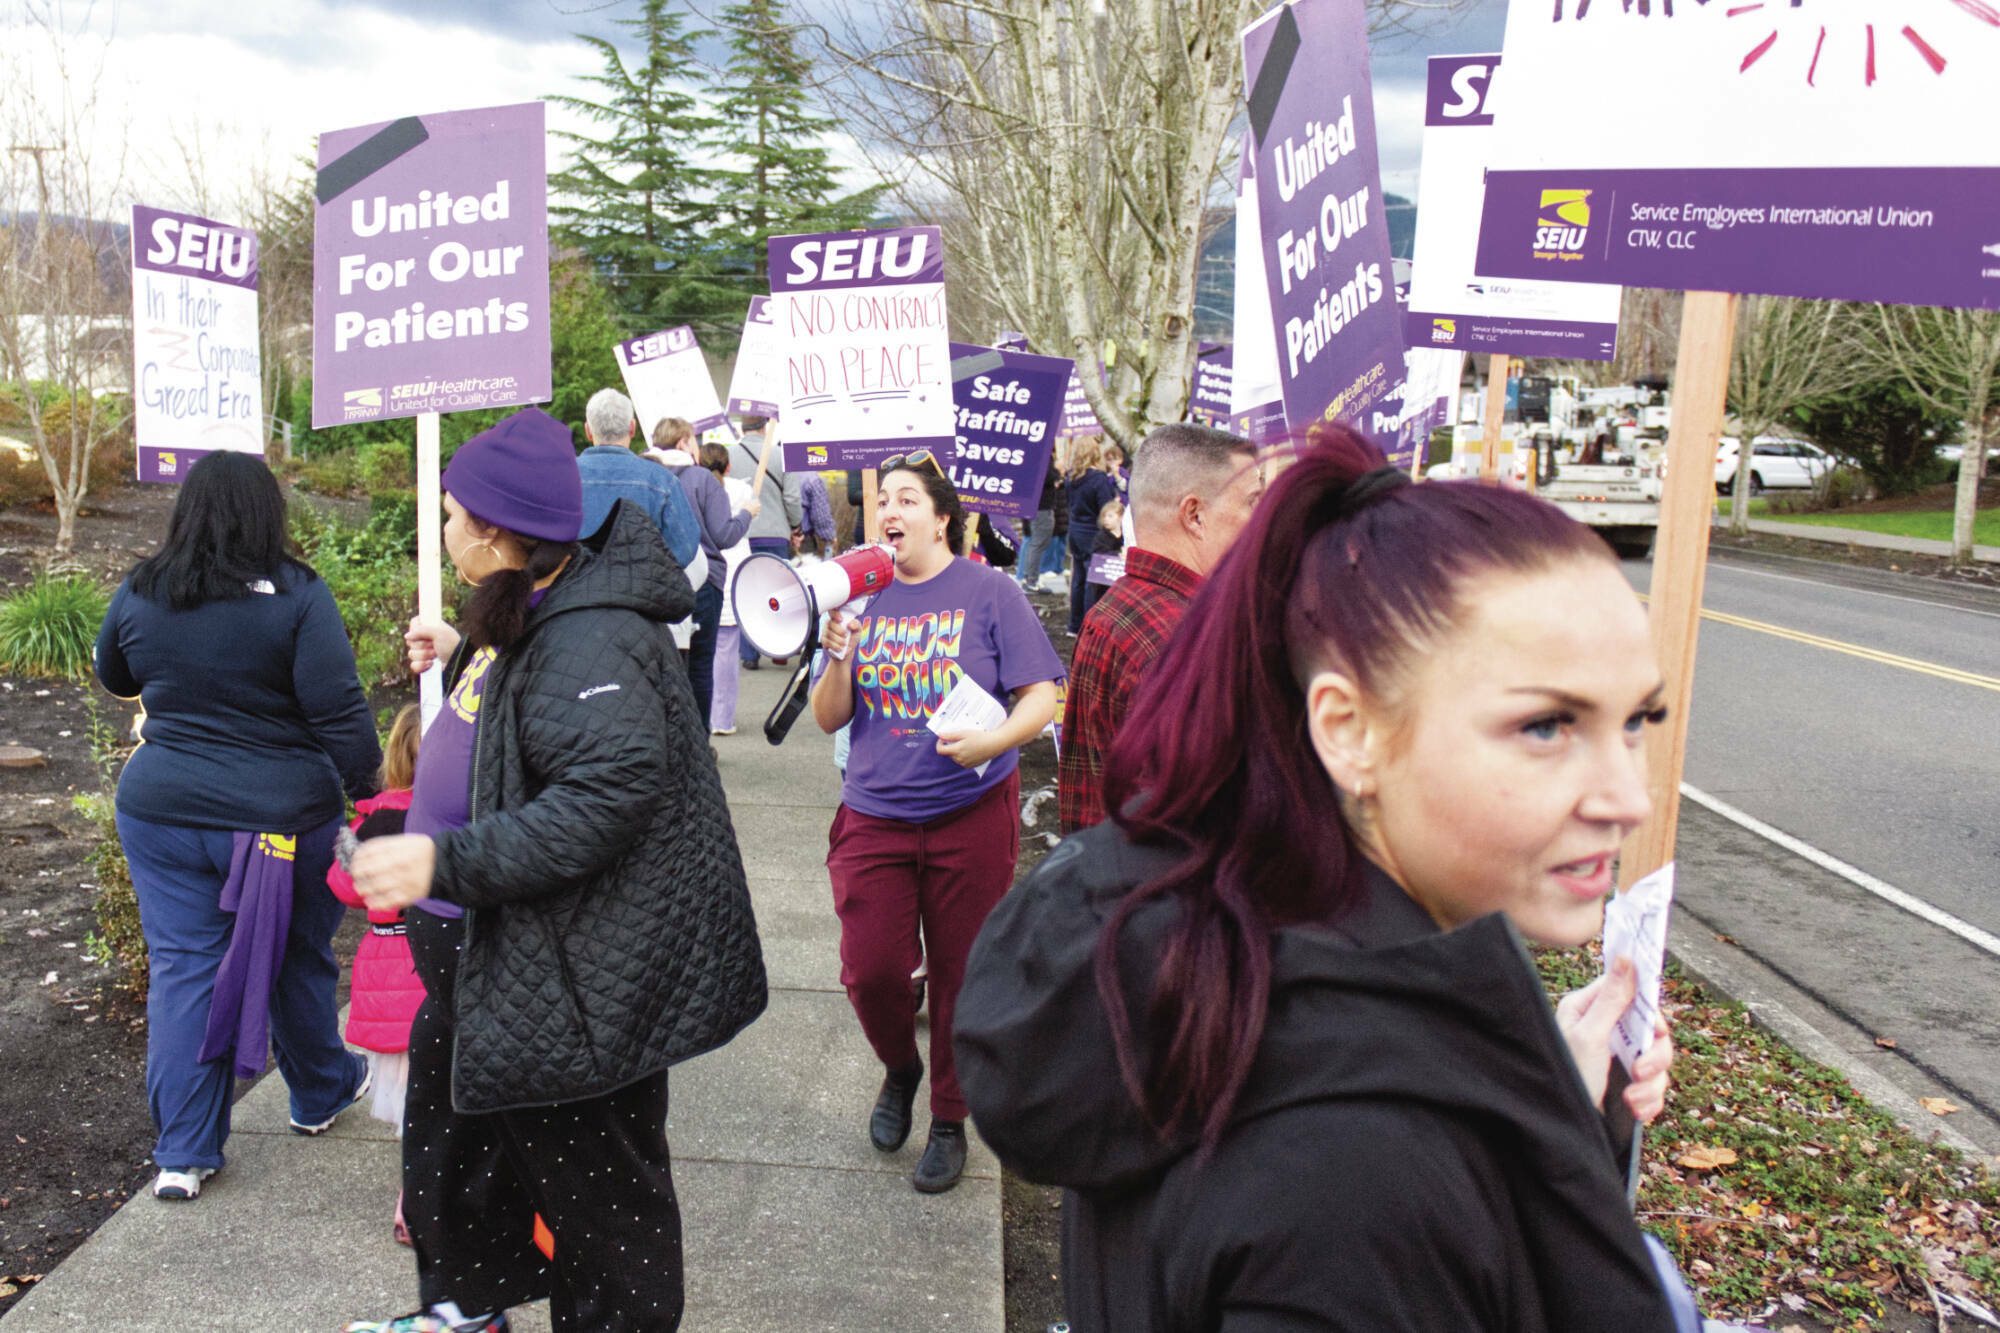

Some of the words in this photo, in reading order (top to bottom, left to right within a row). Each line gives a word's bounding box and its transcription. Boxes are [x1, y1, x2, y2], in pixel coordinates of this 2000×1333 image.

[1274, 94, 1356, 203] United
[352, 179, 509, 237] United
[1630, 202, 1679, 221] Service
[1682, 203, 1765, 229] Employees
[1769, 205, 1873, 226] International
[1877, 206, 1933, 227] Union
[147, 217, 250, 279] SEIU
[786, 234, 929, 285] SEIU
[1277, 229, 1317, 295] For
[1320, 186, 1369, 252] Our
[1532, 227, 1588, 251] SEIU
[1627, 229, 1662, 249] CTW,
[1666, 230, 1697, 249] CLC
[339, 253, 415, 295] For
[428, 241, 524, 282] Our
[146, 276, 165, 323] In
[178, 277, 222, 329] their
[335, 297, 529, 352] Patients
[790, 295, 835, 338] NO
[1285, 262, 1383, 379] Patients
[631, 328, 689, 363] SEIU
[1432, 331, 1455, 340] SEIU
[142, 361, 208, 419] Greed
[217, 380, 252, 419] Era
[789, 353, 827, 396] NO
[840, 344, 942, 391] PEACE.
[970, 376, 1031, 405] Safe
[390, 397, 428, 412] United
[430, 395, 445, 408] for
[448, 391, 489, 406] Quality
[490, 390, 518, 402] Care
[955, 435, 1025, 466] Saves
[948, 464, 1014, 494] Lives
[857, 609, 966, 664] UNION
